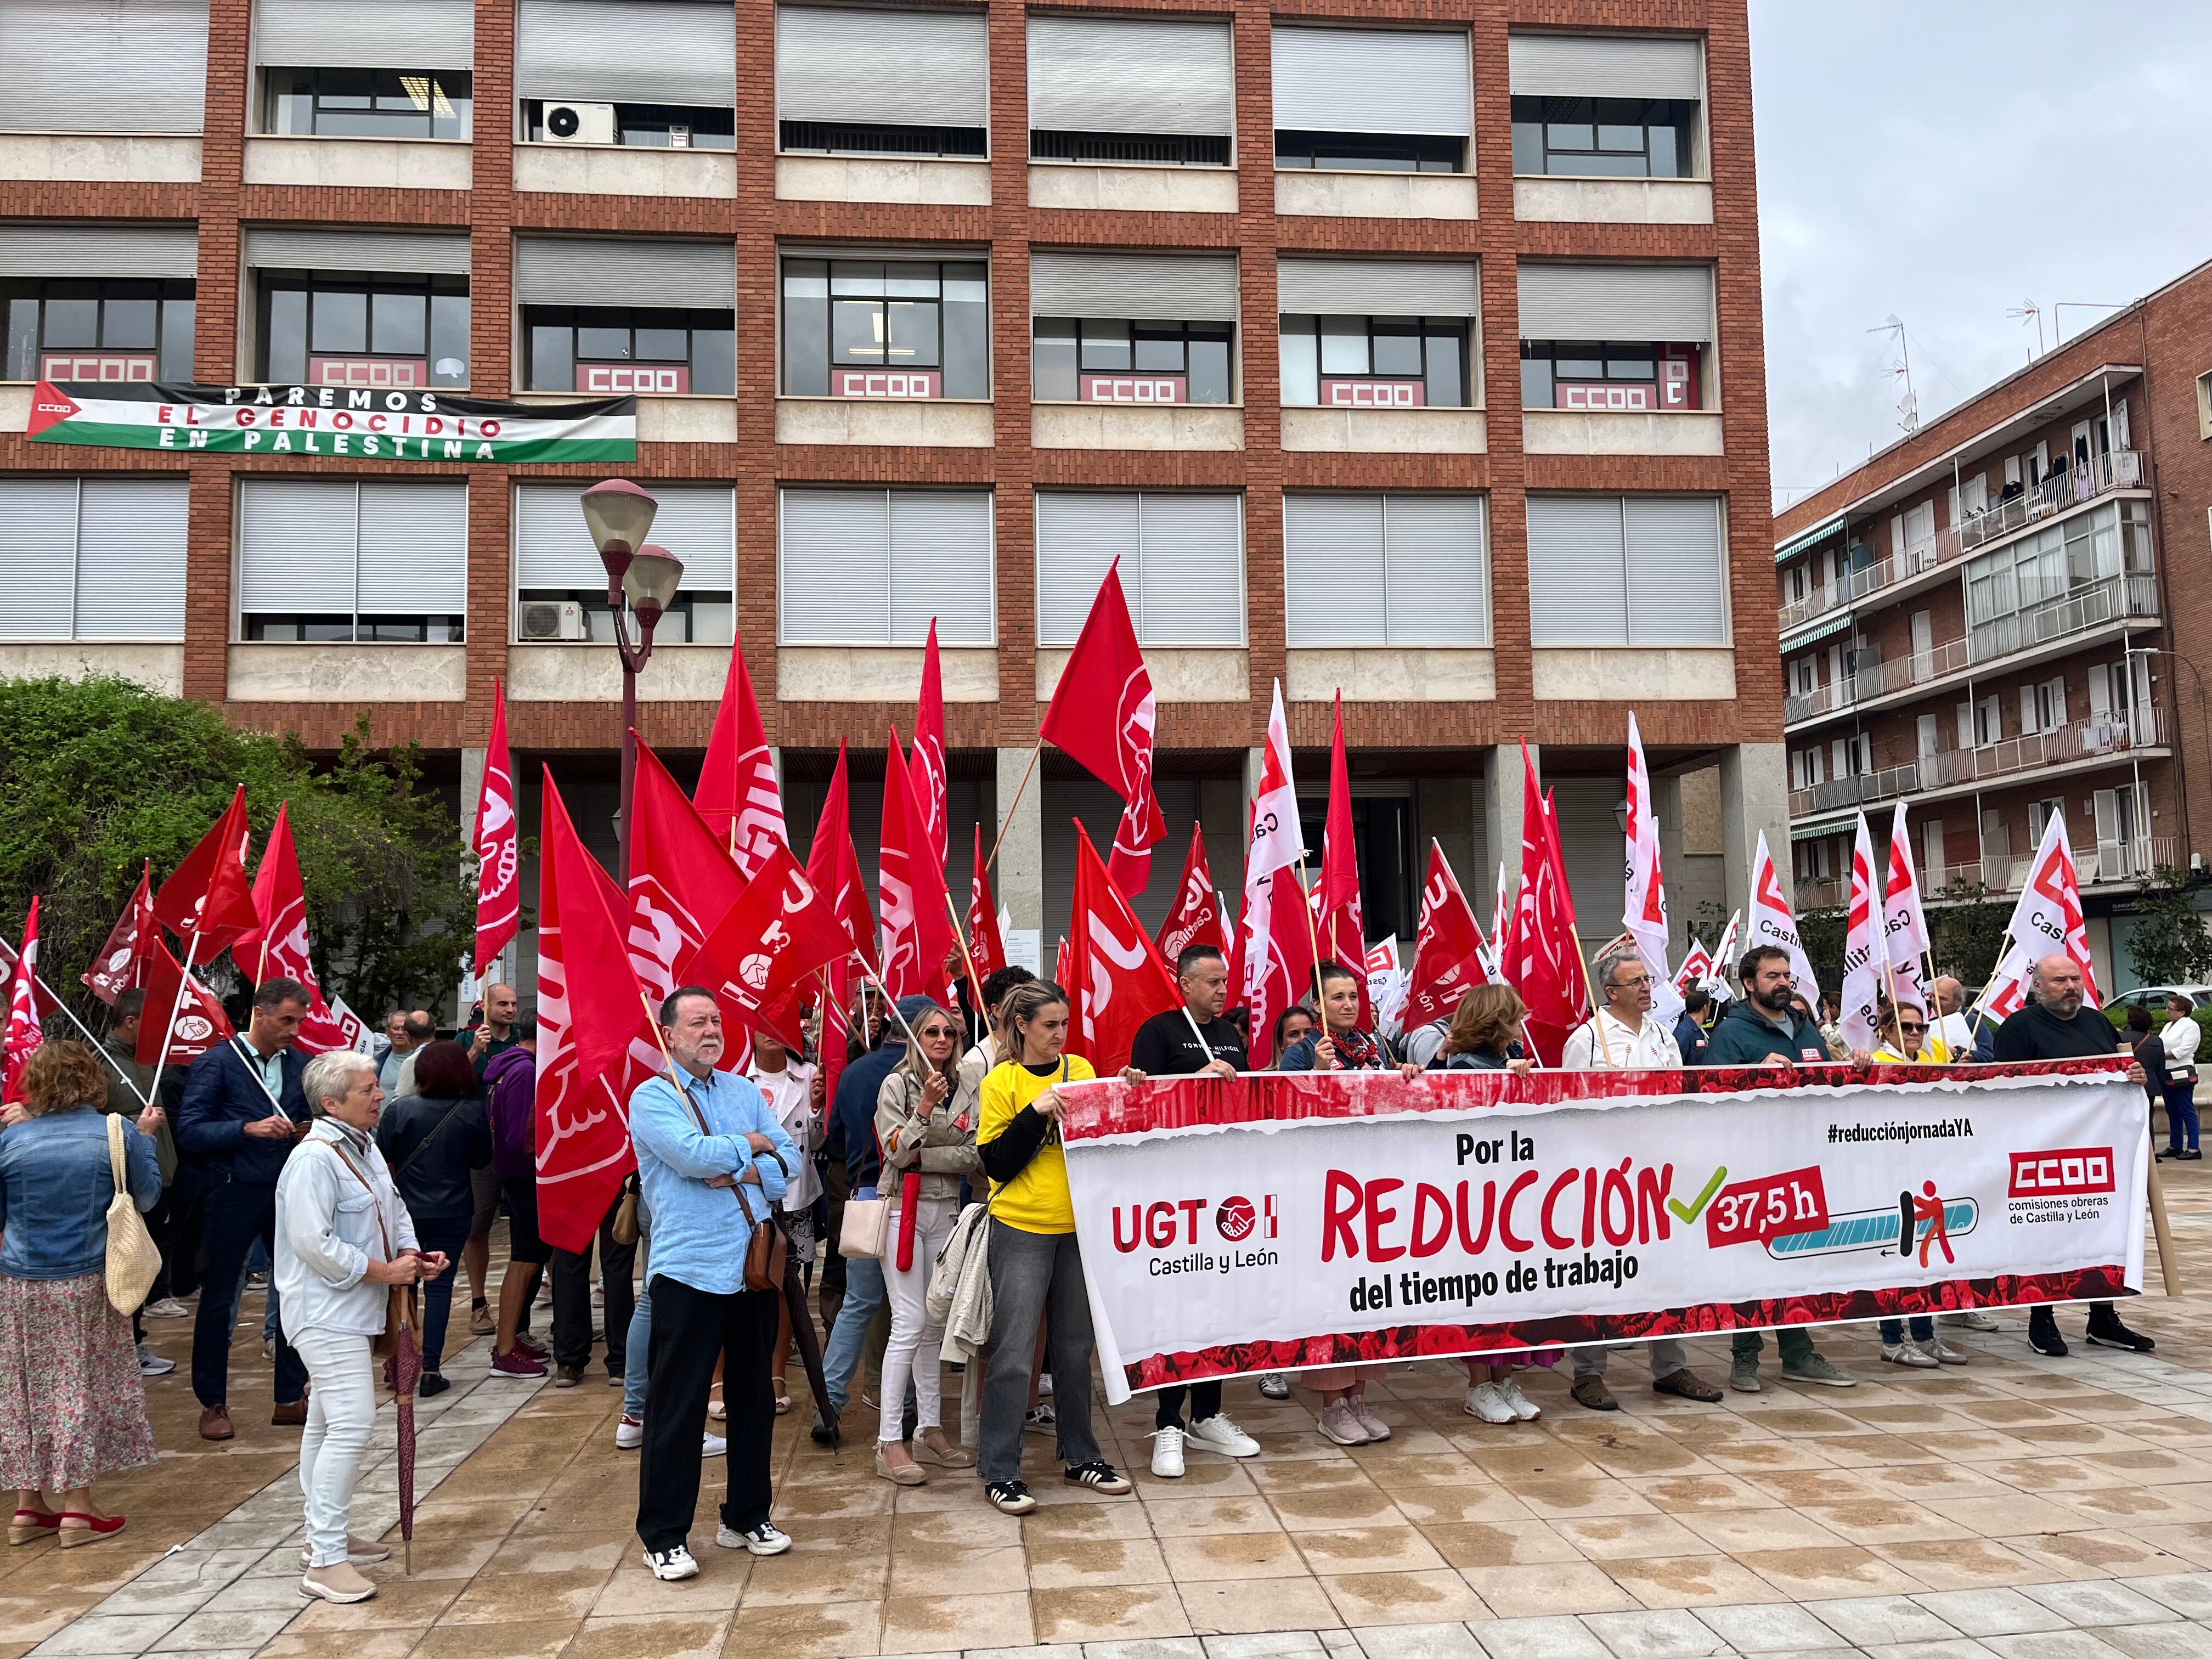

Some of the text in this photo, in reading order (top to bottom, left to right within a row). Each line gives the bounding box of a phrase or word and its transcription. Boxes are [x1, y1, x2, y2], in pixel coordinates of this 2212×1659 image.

[45, 358, 153, 382] CCOO
[323, 362, 414, 386] CCOO
[589, 369, 678, 392] CCOO
[844, 374, 929, 398] CCOO
[1092, 379, 1175, 402] CCOO
[1332, 383, 1413, 406] CCOO
[1566, 387, 1646, 409] CCOO
[38, 403, 71, 413] CCOO
[225, 386, 437, 412] PAREMOS
[158, 405, 500, 438] EL GENOCIDIO
[159, 428, 494, 459] EN PALESTINA
[1827, 1118, 1974, 1144] #reducciónjornadaYA
[1456, 1130, 1534, 1166] Por la
[2015, 1156, 2108, 1188] CCOO
[1321, 1156, 1674, 1262] REDUCCIÓN
[2008, 1197, 2108, 1211] comisiones obreras
[2010, 1209, 2100, 1224] de Castilla y León
[1112, 1198, 1207, 1254] UGT
[1149, 1248, 1278, 1276] Castilla y León
[1350, 1249, 1639, 1312] del tiempo de trabajo
